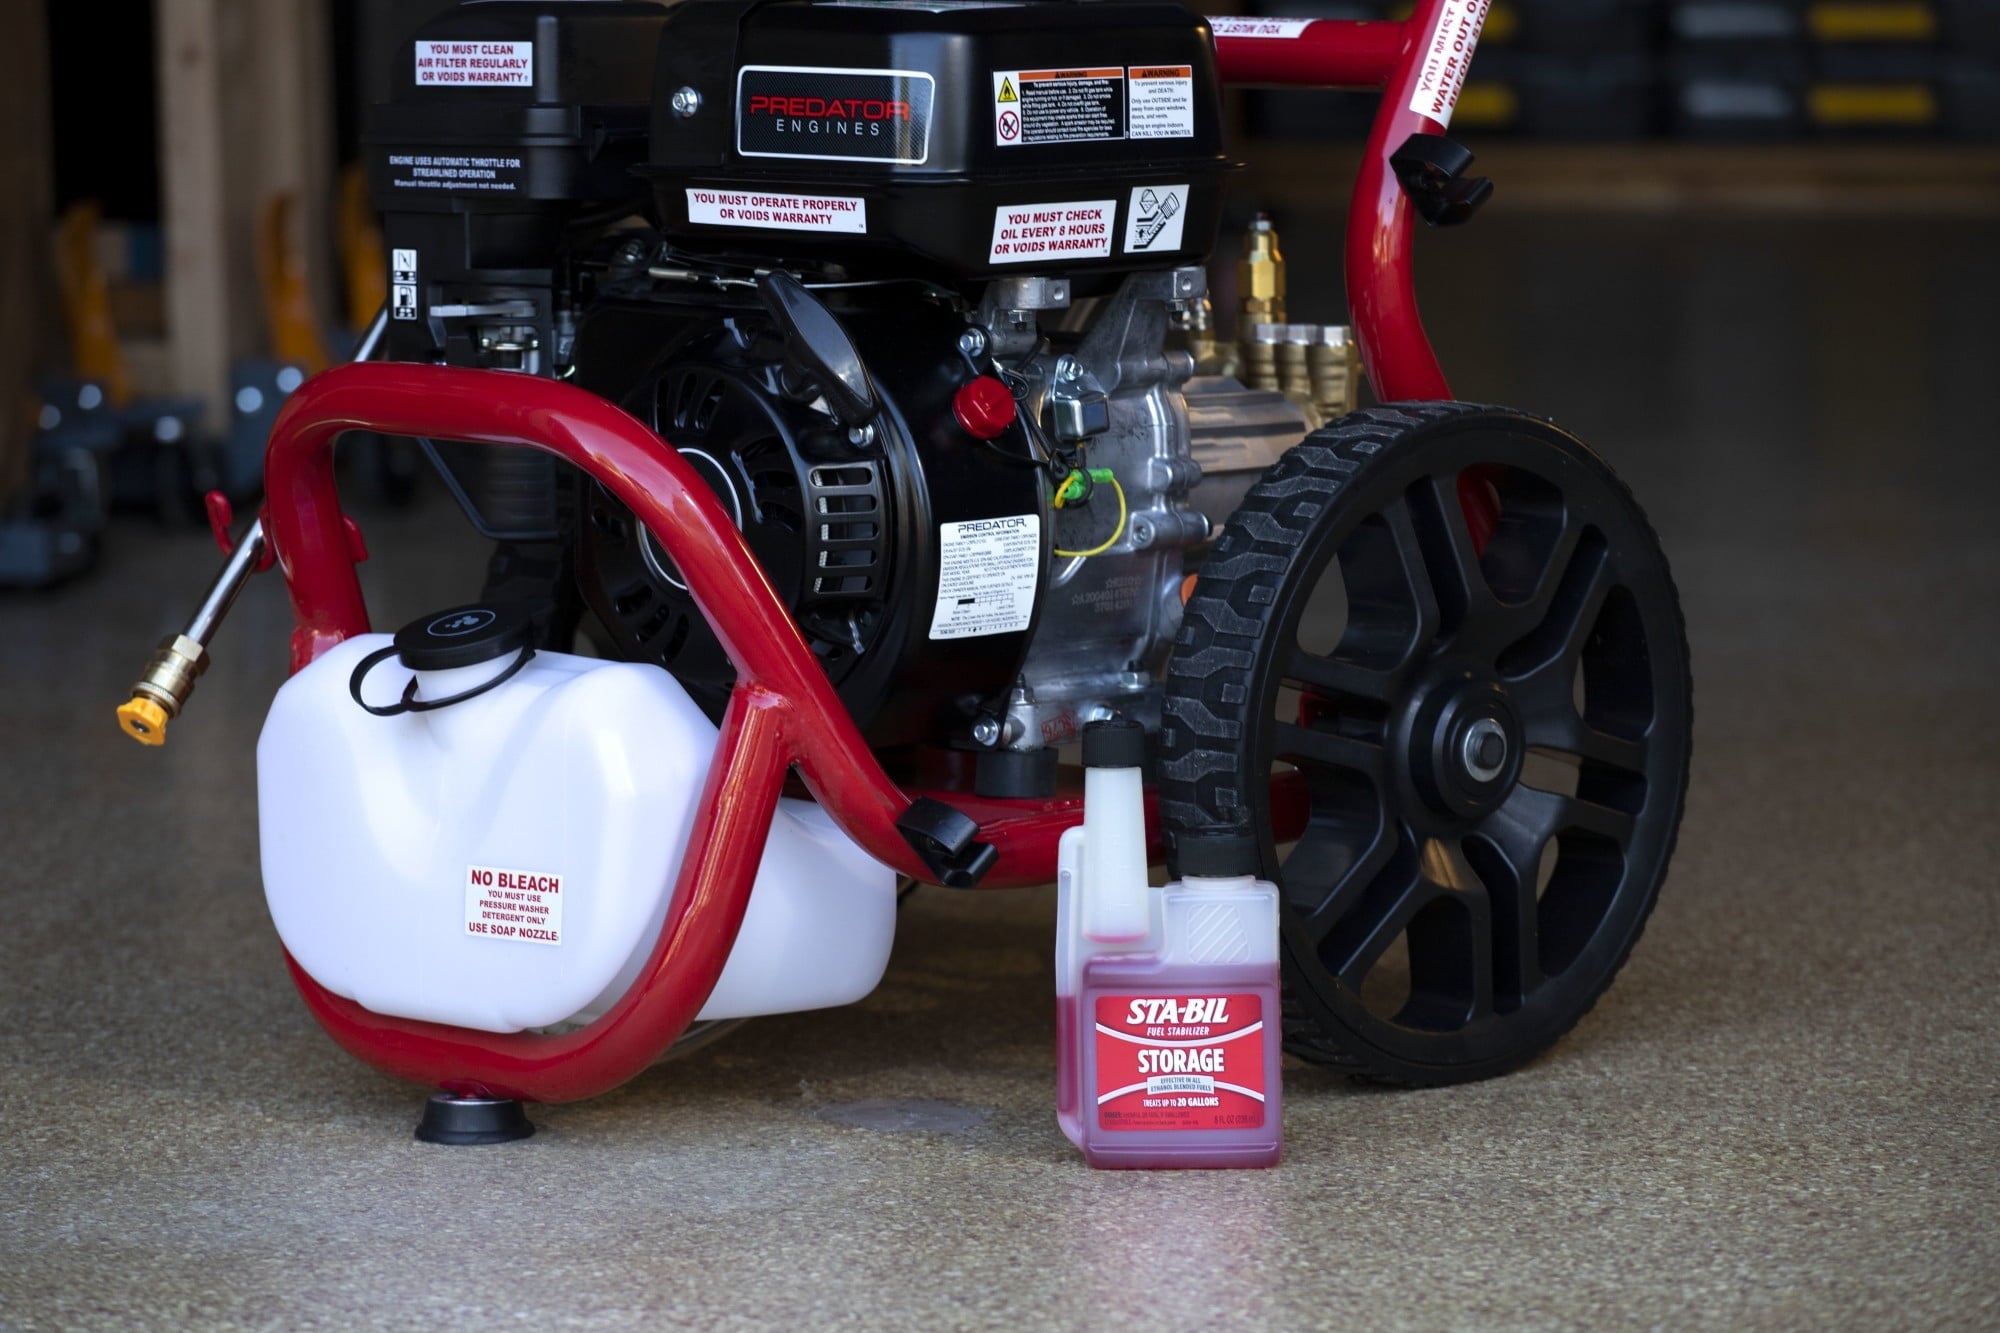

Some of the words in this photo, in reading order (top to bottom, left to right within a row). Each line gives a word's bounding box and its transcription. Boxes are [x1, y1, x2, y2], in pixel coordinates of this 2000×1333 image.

[430, 44, 449, 54] YOU
[452, 44, 478, 54] MUST
[481, 45, 514, 54] CLEAN
[418, 58, 433, 68] AIR
[436, 58, 467, 68] FILTER
[470, 59, 528, 68] REGULARLY
[1432, 56, 1458, 114] WATER
[1453, 16, 1471, 52] OUT
[422, 72, 434, 81] OR
[438, 72, 465, 81] VOIDS
[468, 72, 522, 82] WARRANTY
[1146, 69, 1180, 78] WARNING
[751, 96, 911, 121] PREDATOR
[776, 119, 880, 136] ENGINES
[390, 155, 414, 164] ENGINE
[415, 156, 432, 165] USES
[432, 156, 470, 166] AUTOMATIC
[471, 158, 504, 168] THROTTLE
[506, 158, 520, 168] FOR
[413, 168, 458, 178] STREAMLINED
[458, 169, 496, 178] OPERATION
[394, 179, 416, 187] Manual
[418, 180, 441, 188] throttle
[442, 181, 477, 190] adjustment
[694, 192, 716, 204] YOU
[718, 194, 748, 206] MUST
[752, 195, 800, 208] OPERATE
[803, 198, 857, 212] PROPERLY
[720, 208, 735, 219] OR
[738, 210, 770, 221] VOIDS
[773, 211, 832, 224] WARRANTY
[1008, 214, 1030, 225] YOU
[1032, 212, 1063, 224] MUST
[1066, 209, 1102, 221] CHECK
[1001, 229, 1018, 240] OIL
[1022, 226, 1056, 238] EVERY
[1059, 226, 1066, 236] 8
[1068, 224, 1105, 235] HOURS
[994, 244, 1010, 254] OR
[1012, 242, 1046, 253] VOIDS
[1048, 238, 1108, 250] WARRANTY
[958, 518, 1024, 534] PREDATOR
[472, 870, 493, 886] NO
[498, 872, 559, 894] BLEACH
[488, 890, 502, 898] YOU
[504, 892, 525, 900] MUST
[527, 894, 542, 902] USE
[480, 900, 516, 910] PRESSURE
[519, 904, 549, 914] WASHER
[482, 911, 525, 922] DETERGENT
[526, 916, 546, 925] ONLY
[469, 922, 488, 933] USE
[490, 925, 516, 936] SOAP
[519, 928, 558, 940] NOZZLE
[1126, 998, 1229, 1024] STA-BIL
[1147, 1027, 1164, 1036] FUEL
[1168, 1026, 1210, 1036] STABILIZER
[1138, 1048, 1224, 1073] STORAGE
[1143, 1099, 1162, 1107] TREATS
[1178, 1098, 1186, 1106] 20
[1188, 1097, 1219, 1106] GALLONS
